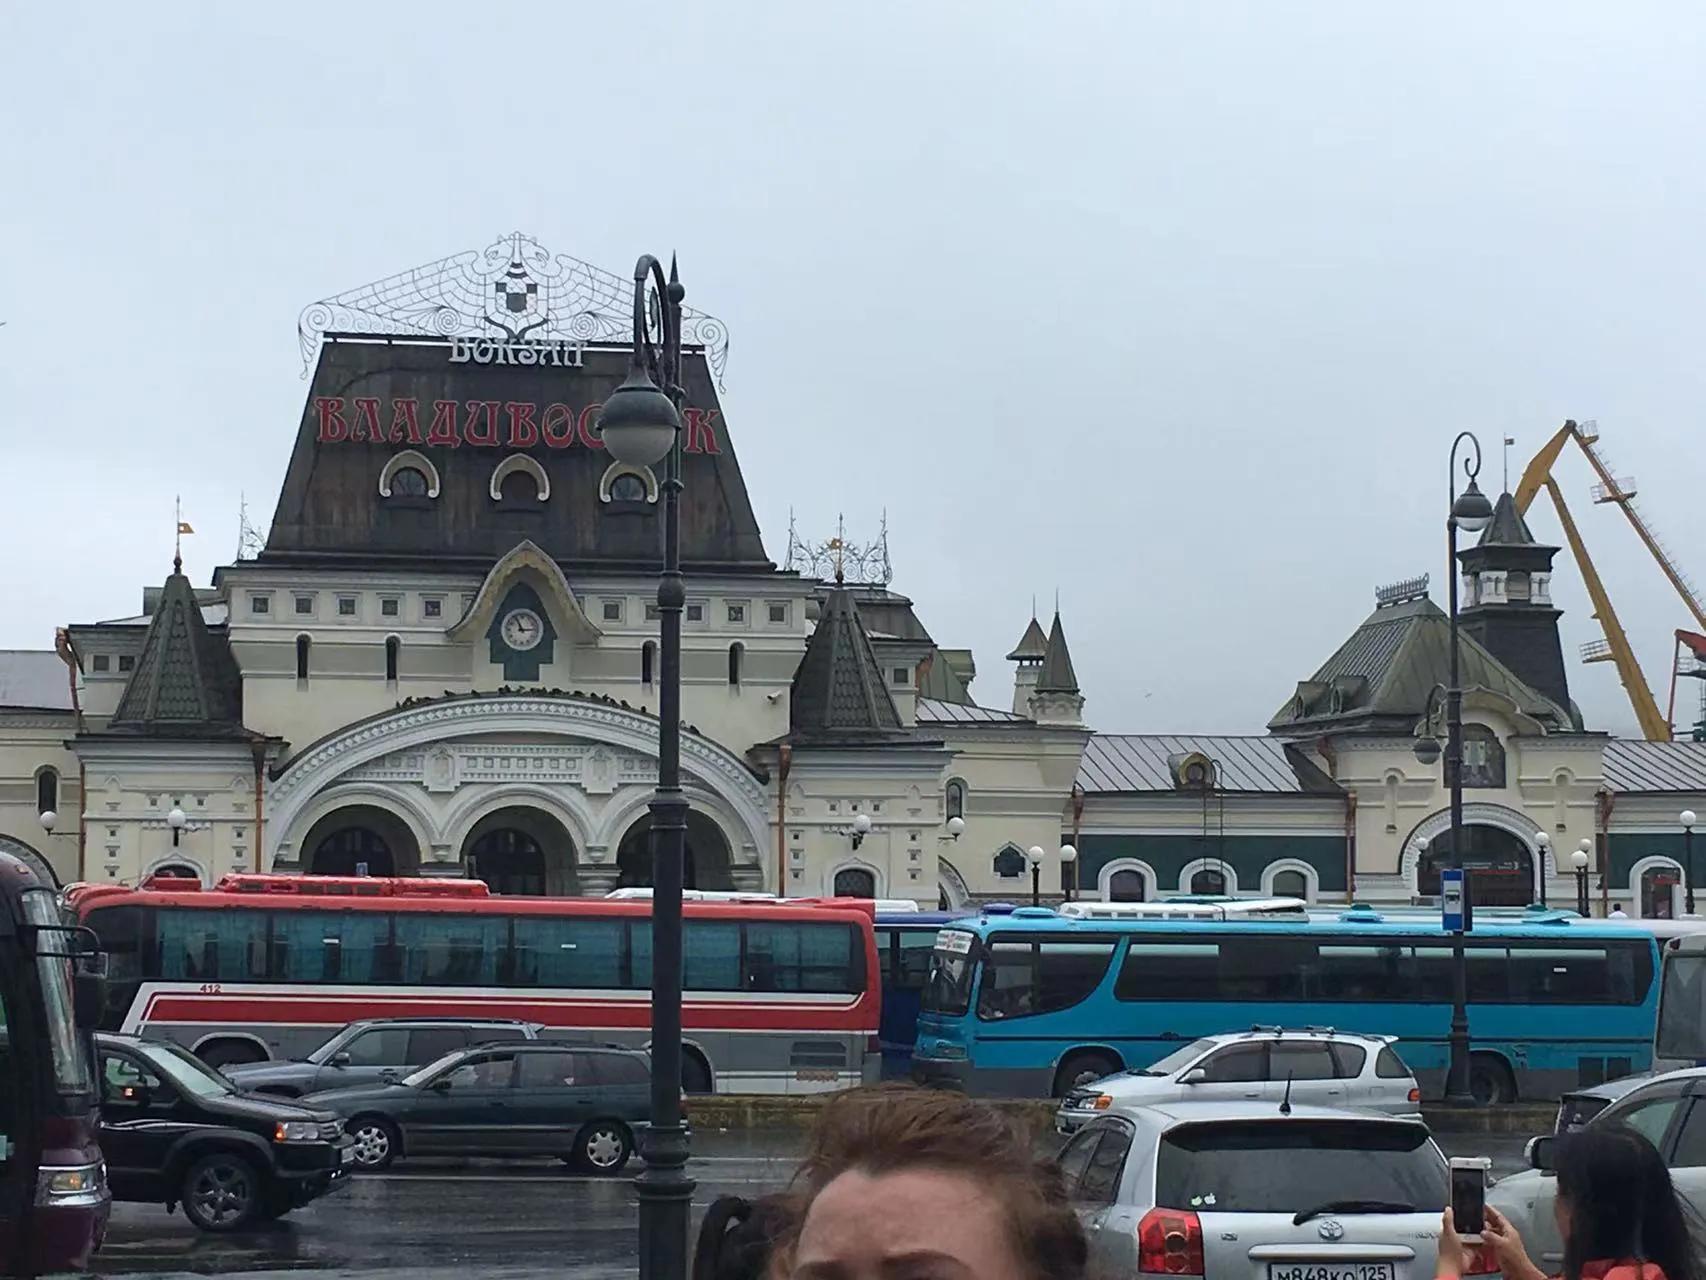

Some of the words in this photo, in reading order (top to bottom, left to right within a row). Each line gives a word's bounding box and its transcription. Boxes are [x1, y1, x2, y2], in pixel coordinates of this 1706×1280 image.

[447, 336, 588, 367] ВОКЗАЛ
[313, 396, 723, 454] ВЛАДИВОСК
[200, 984, 222, 995] 412
[1359, 1266, 1387, 1280] 125
